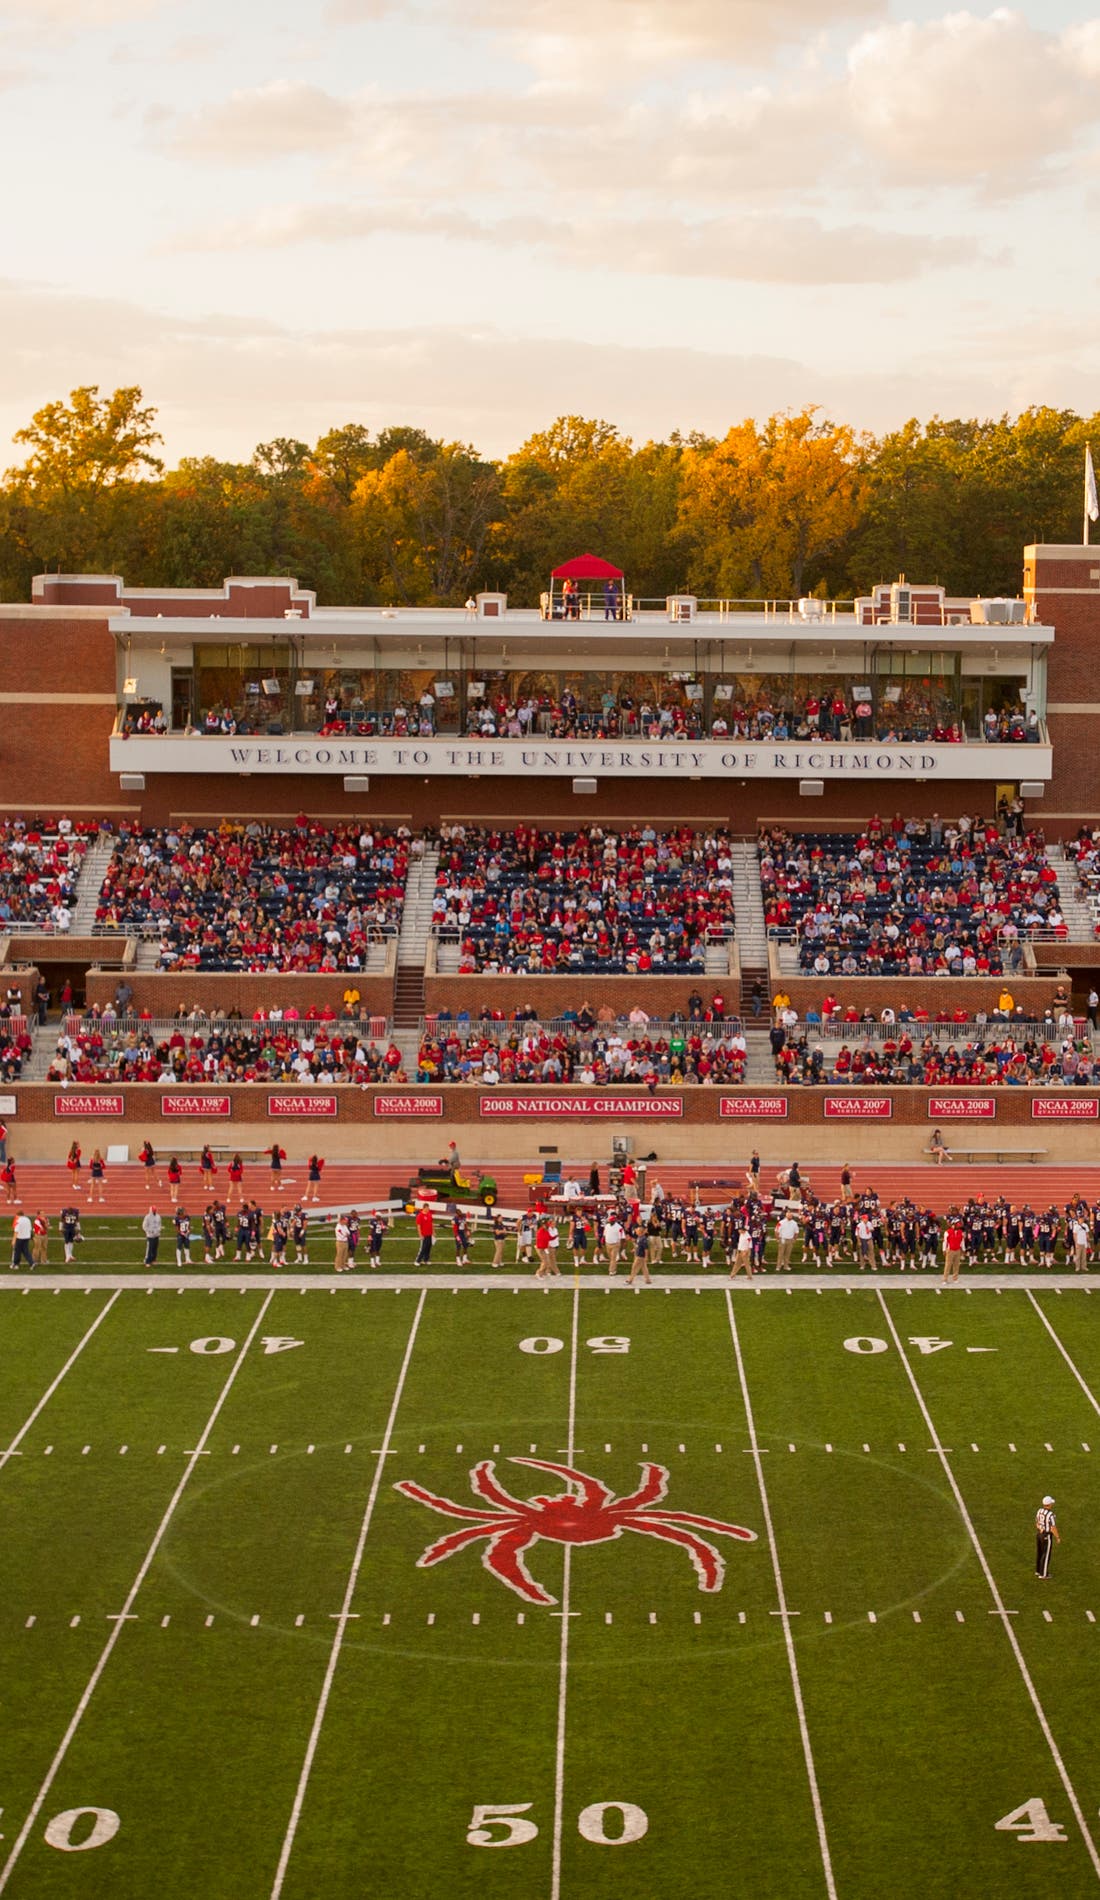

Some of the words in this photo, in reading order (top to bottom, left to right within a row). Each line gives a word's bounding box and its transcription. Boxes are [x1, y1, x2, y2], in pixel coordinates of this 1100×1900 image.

[230, 748, 377, 764] WELCOME
[393, 750, 430, 765] TO
[446, 751, 503, 766] THE
[521, 751, 703, 768] UNIVERSITY
[721, 753, 757, 769] OF
[774, 754, 937, 770] RICHMOND
[61, 1098, 91, 1107] NCAA
[94, 1098, 117, 1107] 1984
[169, 1098, 199, 1107] NCAA
[203, 1098, 224, 1107] 1987
[275, 1099, 305, 1107] NCAA
[309, 1099, 330, 1107] 1998
[381, 1099, 411, 1107] NCAA
[414, 1099, 437, 1107] 2000
[484, 1100, 513, 1111] 2008
[517, 1101, 590, 1111] NATIONAL
[594, 1101, 680, 1112] CHAMPIONS
[727, 1100, 756, 1109] NCAA
[759, 1100, 782, 1109] 2005
[831, 1100, 860, 1109] NCAA
[863, 1100, 885, 1109] 2007
[935, 1101, 965, 1109] NCAA
[968, 1101, 989, 1109] 2008
[1038, 1101, 1068, 1110] NCAA
[1071, 1101, 1093, 1110] 2009
